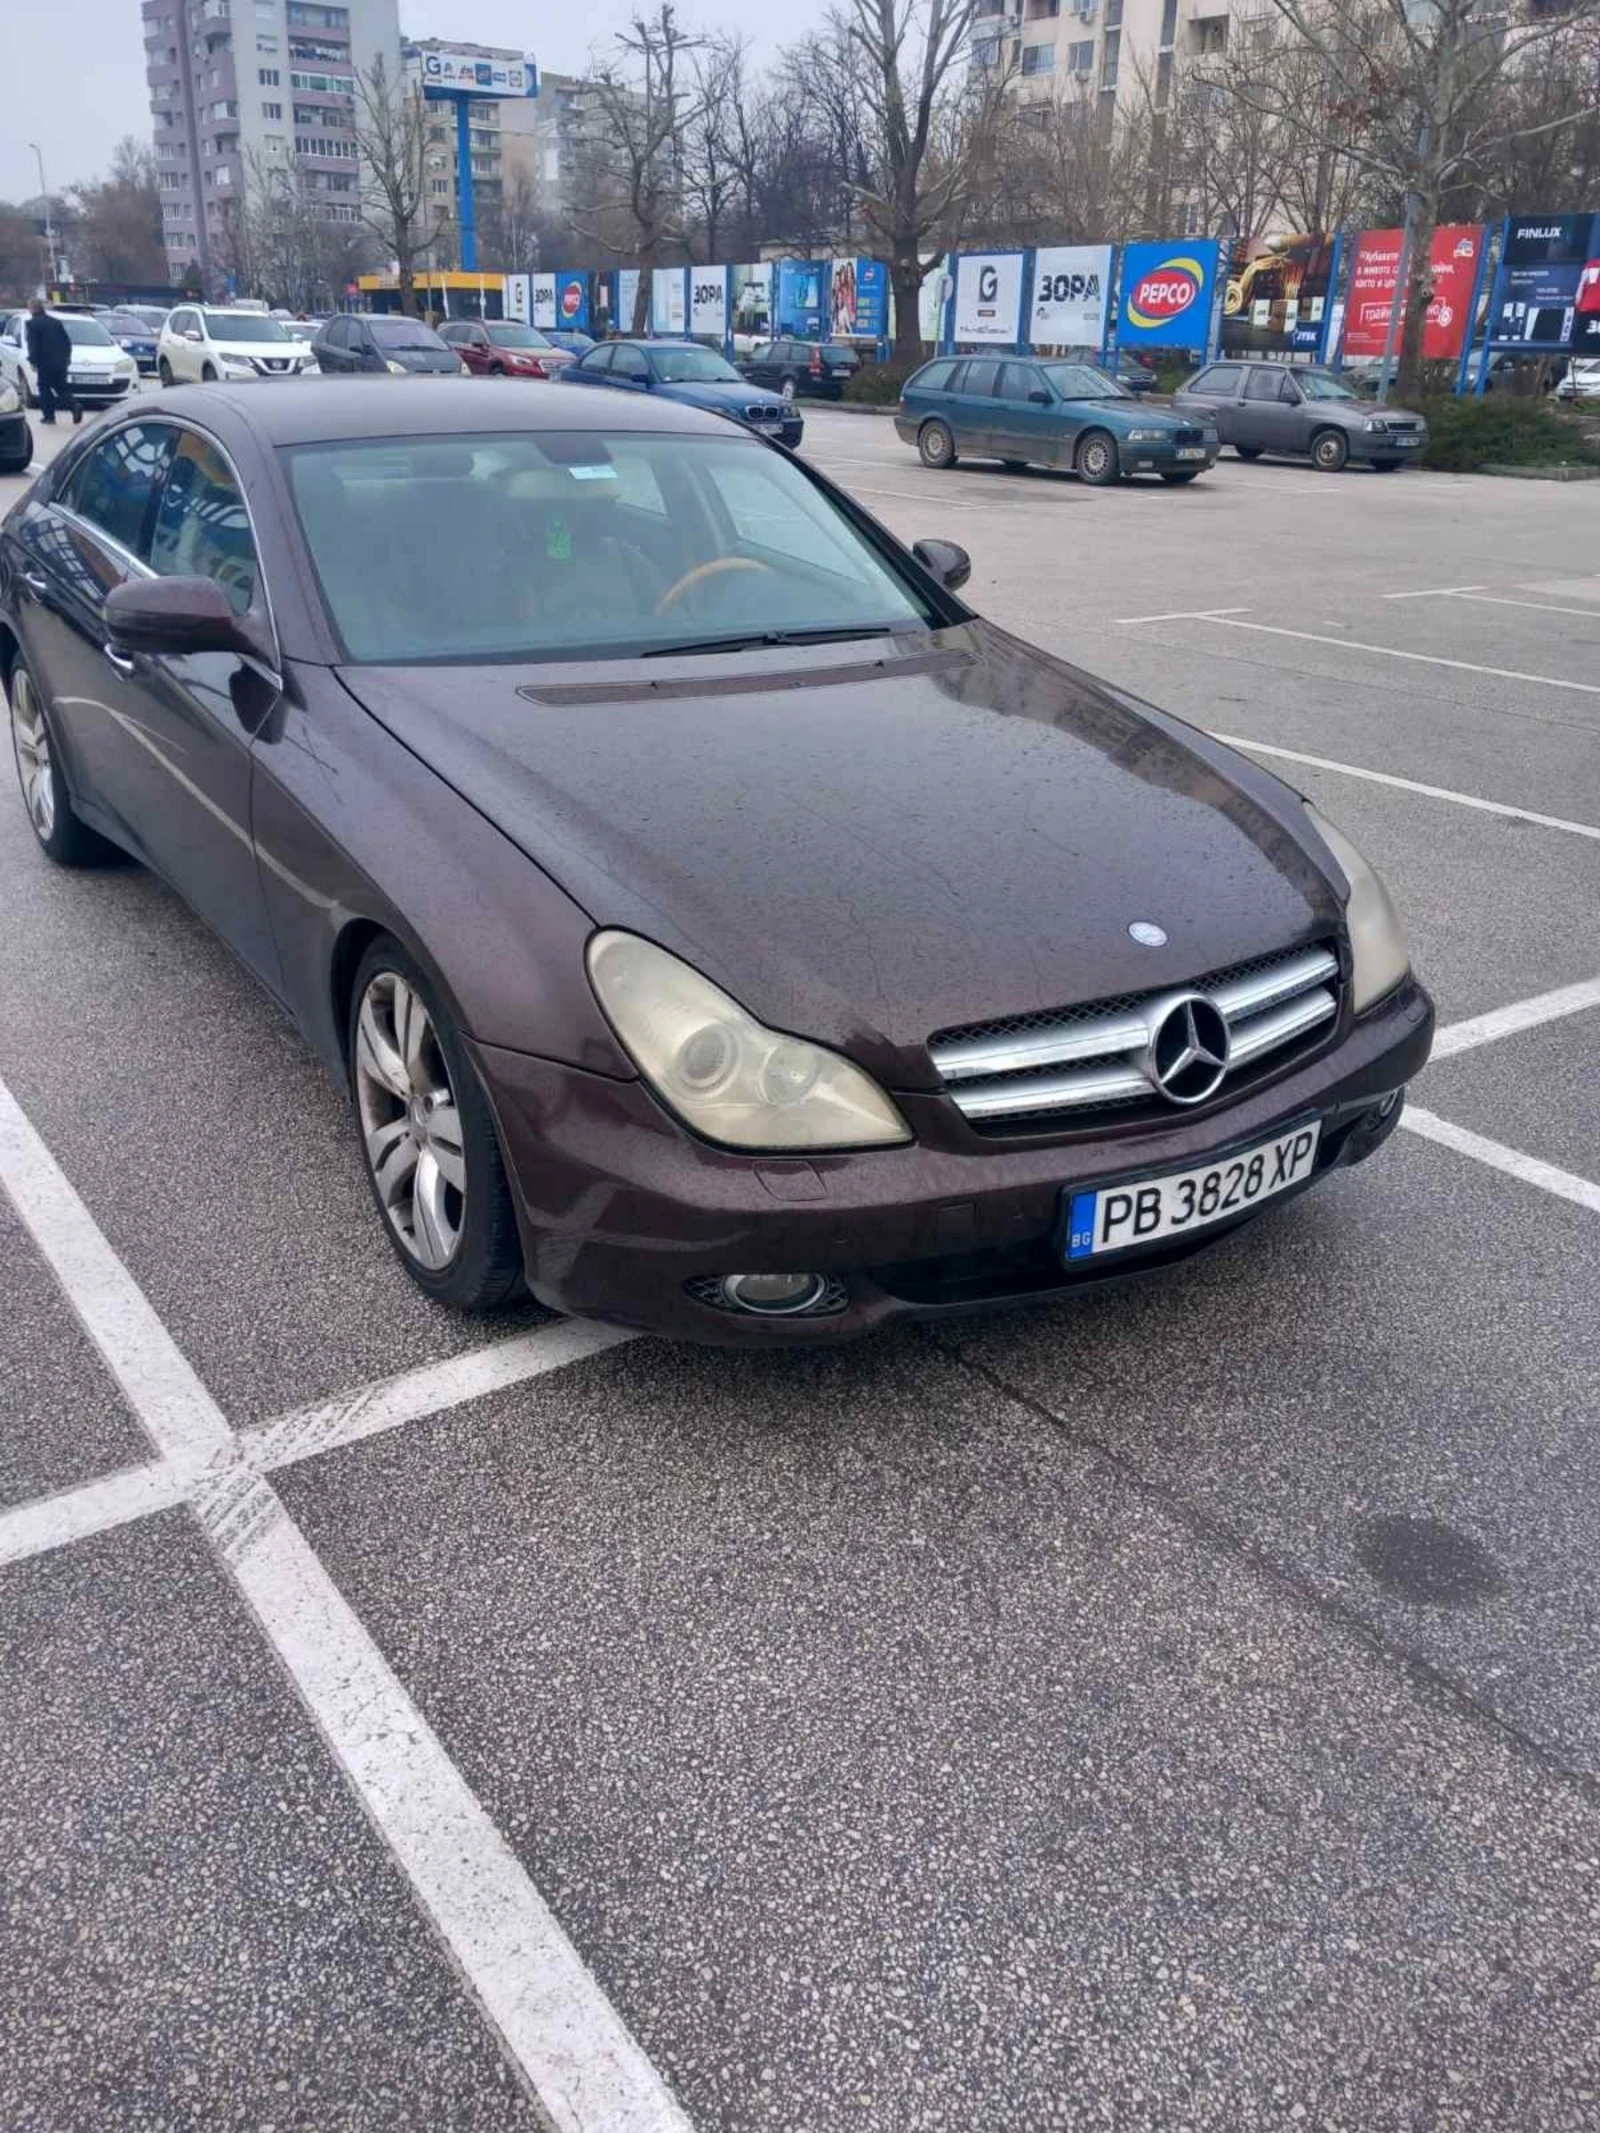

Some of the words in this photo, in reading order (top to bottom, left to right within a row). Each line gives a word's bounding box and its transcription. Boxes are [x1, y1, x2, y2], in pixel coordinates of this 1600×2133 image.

[1516, 226, 1562, 239] FINLUX
[1038, 273, 1099, 302] ЗОРА
[1138, 282, 1191, 305] PEPCO
[1101, 1187, 1162, 1244] PB
[1170, 1153, 1265, 1226] 3828
[1268, 1130, 1313, 1189] XP
[1071, 1230, 1092, 1248] BG
